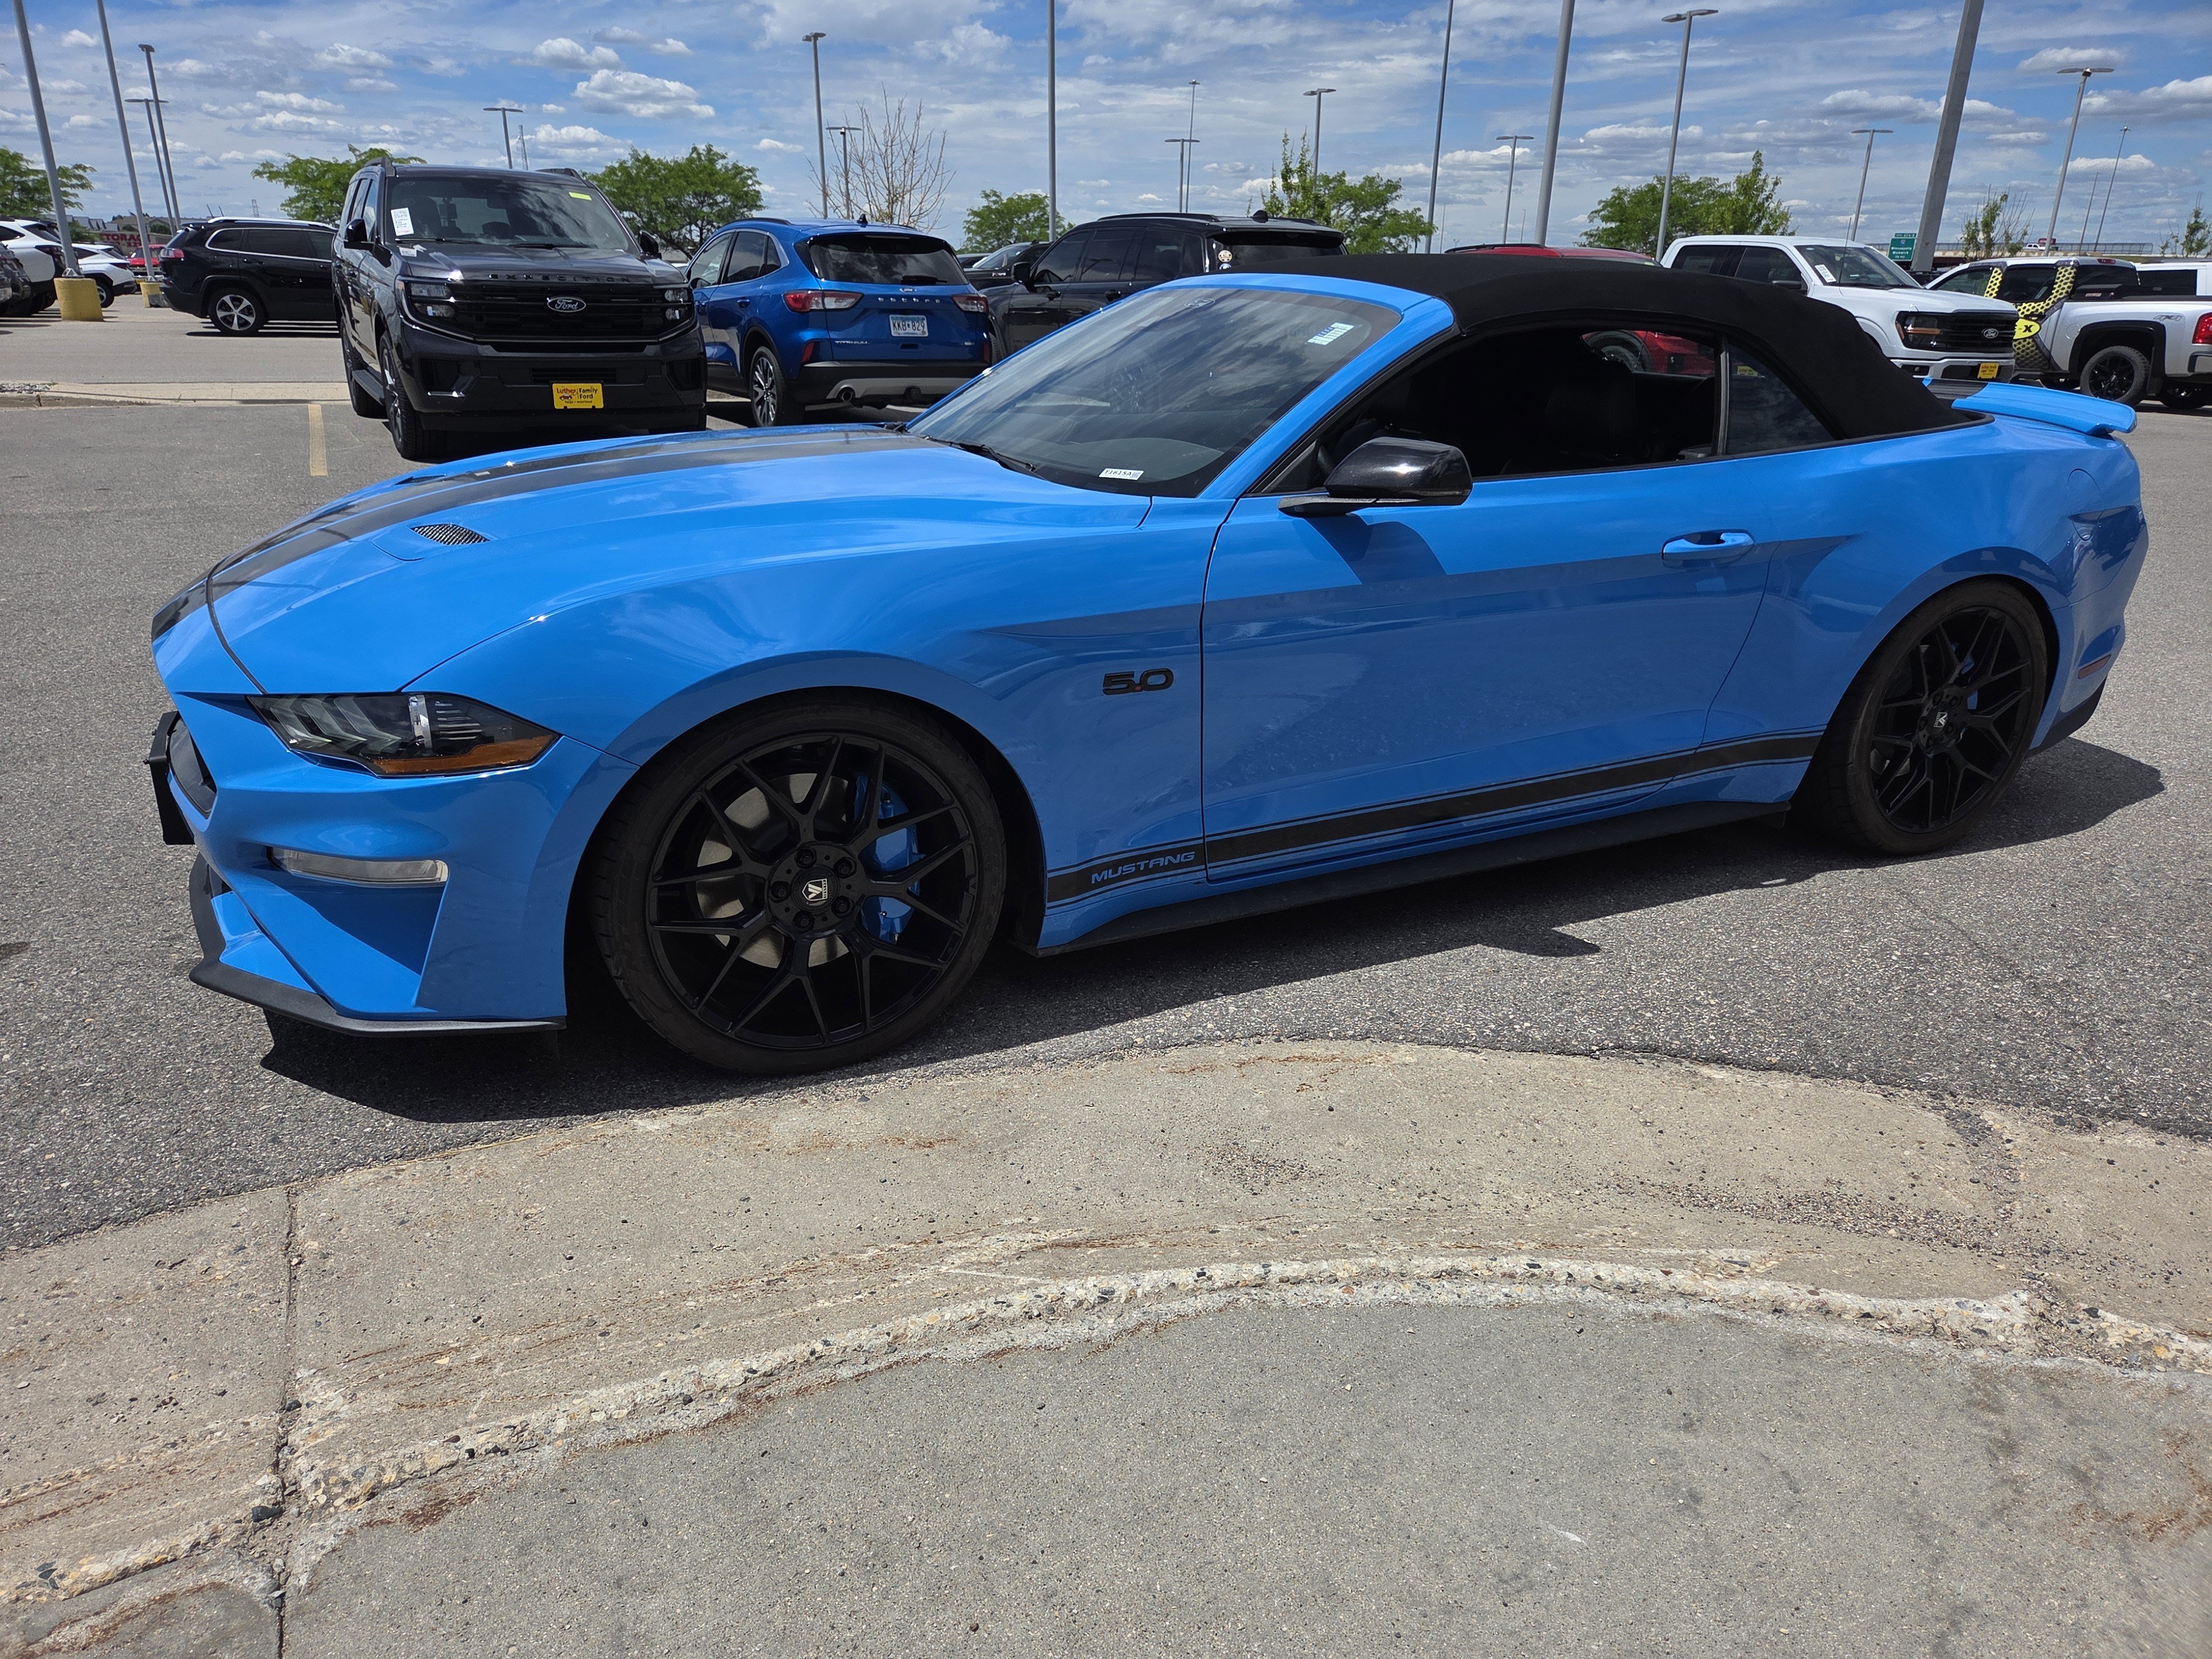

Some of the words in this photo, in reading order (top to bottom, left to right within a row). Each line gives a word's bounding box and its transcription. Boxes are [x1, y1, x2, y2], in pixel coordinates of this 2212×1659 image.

[555, 299, 578, 310] Ford
[893, 321, 906, 331] KKB
[912, 321, 925, 331] 829
[1102, 668, 1173, 695] 5.0
[1092, 852, 1195, 884] MUSTANG
